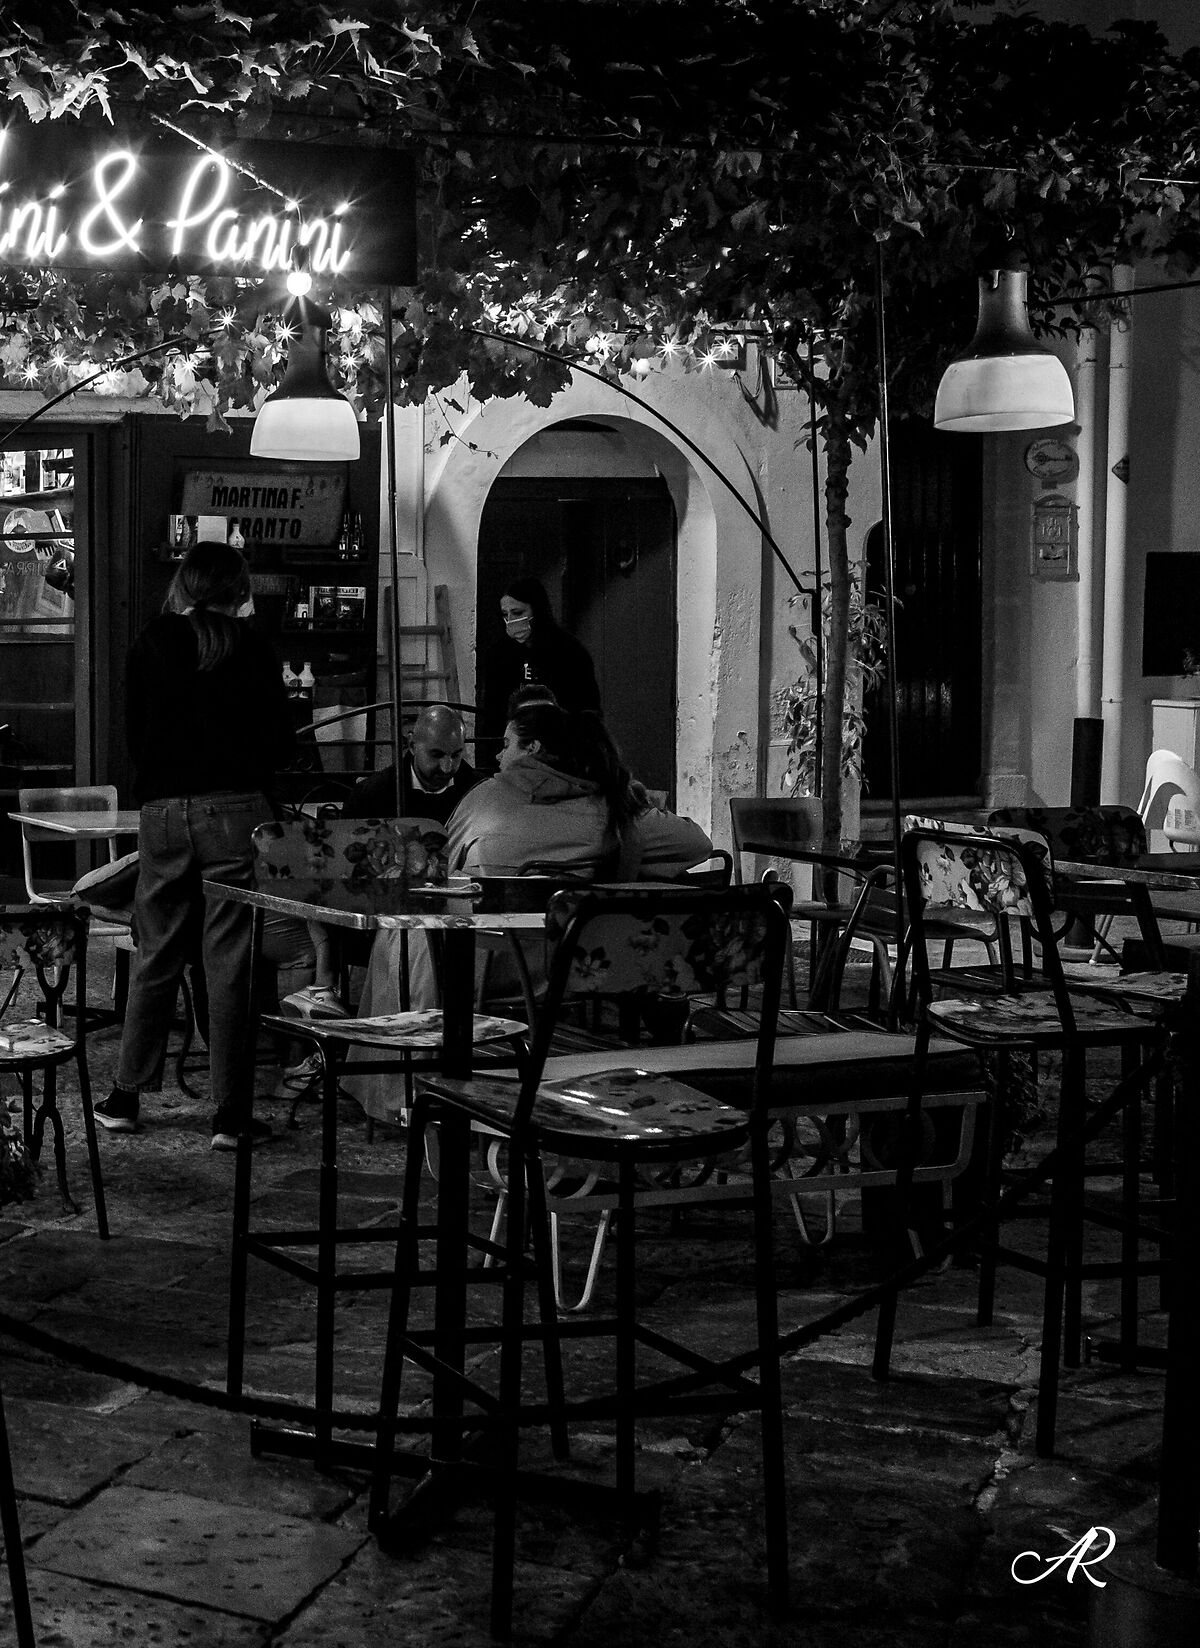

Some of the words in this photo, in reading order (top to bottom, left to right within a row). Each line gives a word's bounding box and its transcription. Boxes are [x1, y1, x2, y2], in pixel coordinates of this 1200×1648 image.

[79, 150, 143, 256] &
[166, 152, 352, 273] Panini
[211, 486, 289, 509] MARTINA
